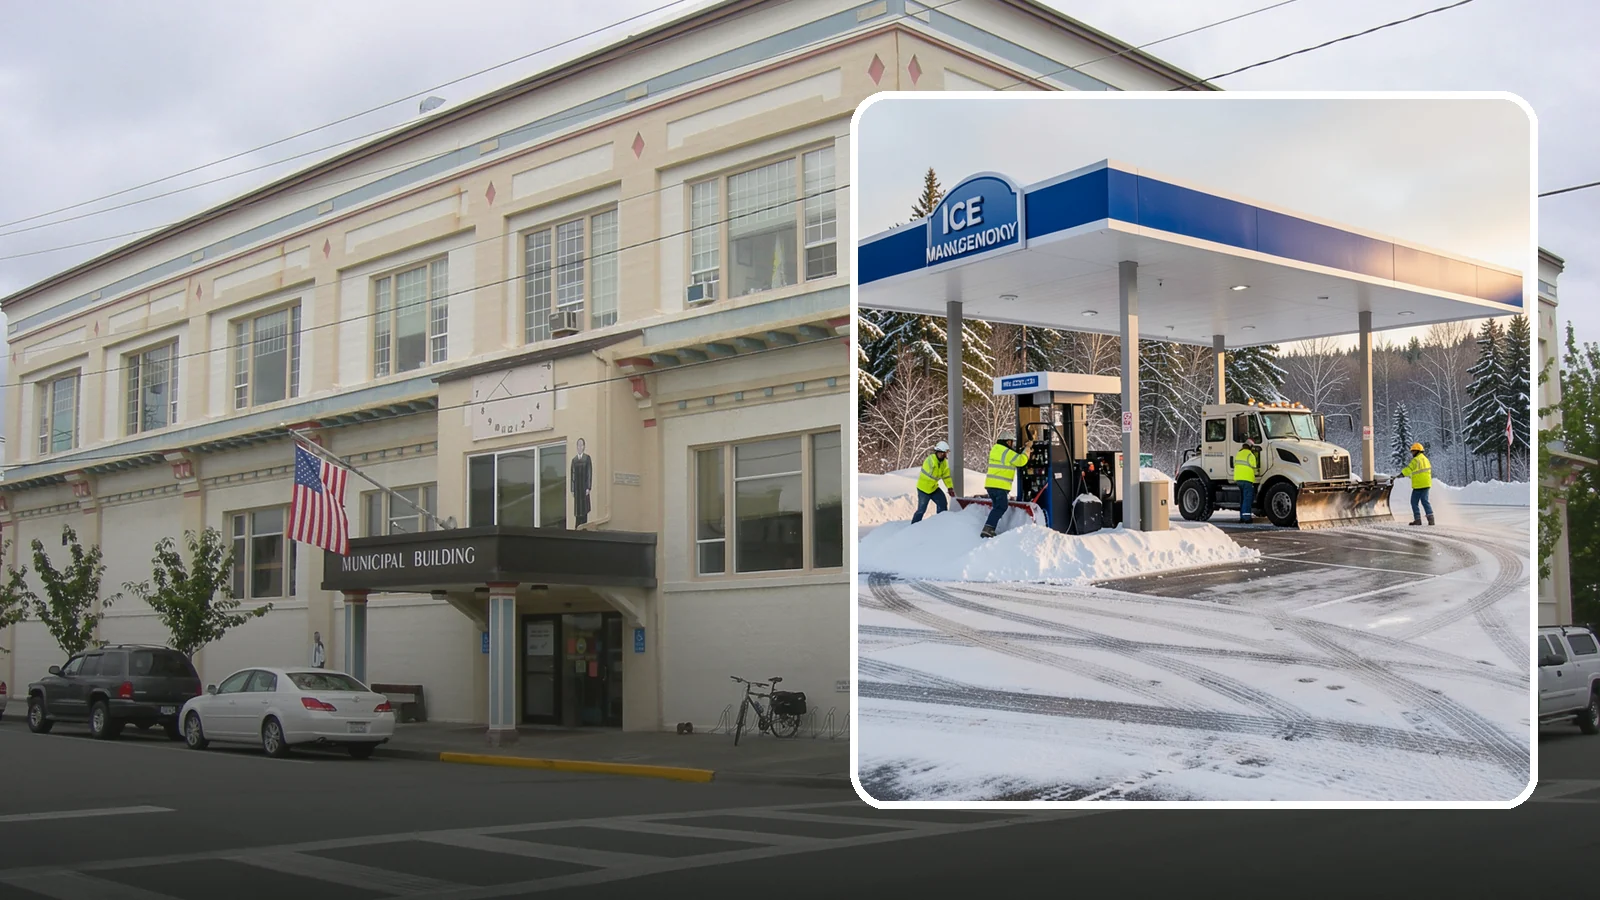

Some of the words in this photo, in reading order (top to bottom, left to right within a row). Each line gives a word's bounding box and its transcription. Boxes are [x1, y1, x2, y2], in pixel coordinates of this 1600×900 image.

[942, 195, 983, 235] ICE
[480, 407, 485, 415] 8
[487, 417, 492, 425] 9
[342, 552, 405, 572] MUNICIPAL
[414, 546, 475, 567] BUILDING
